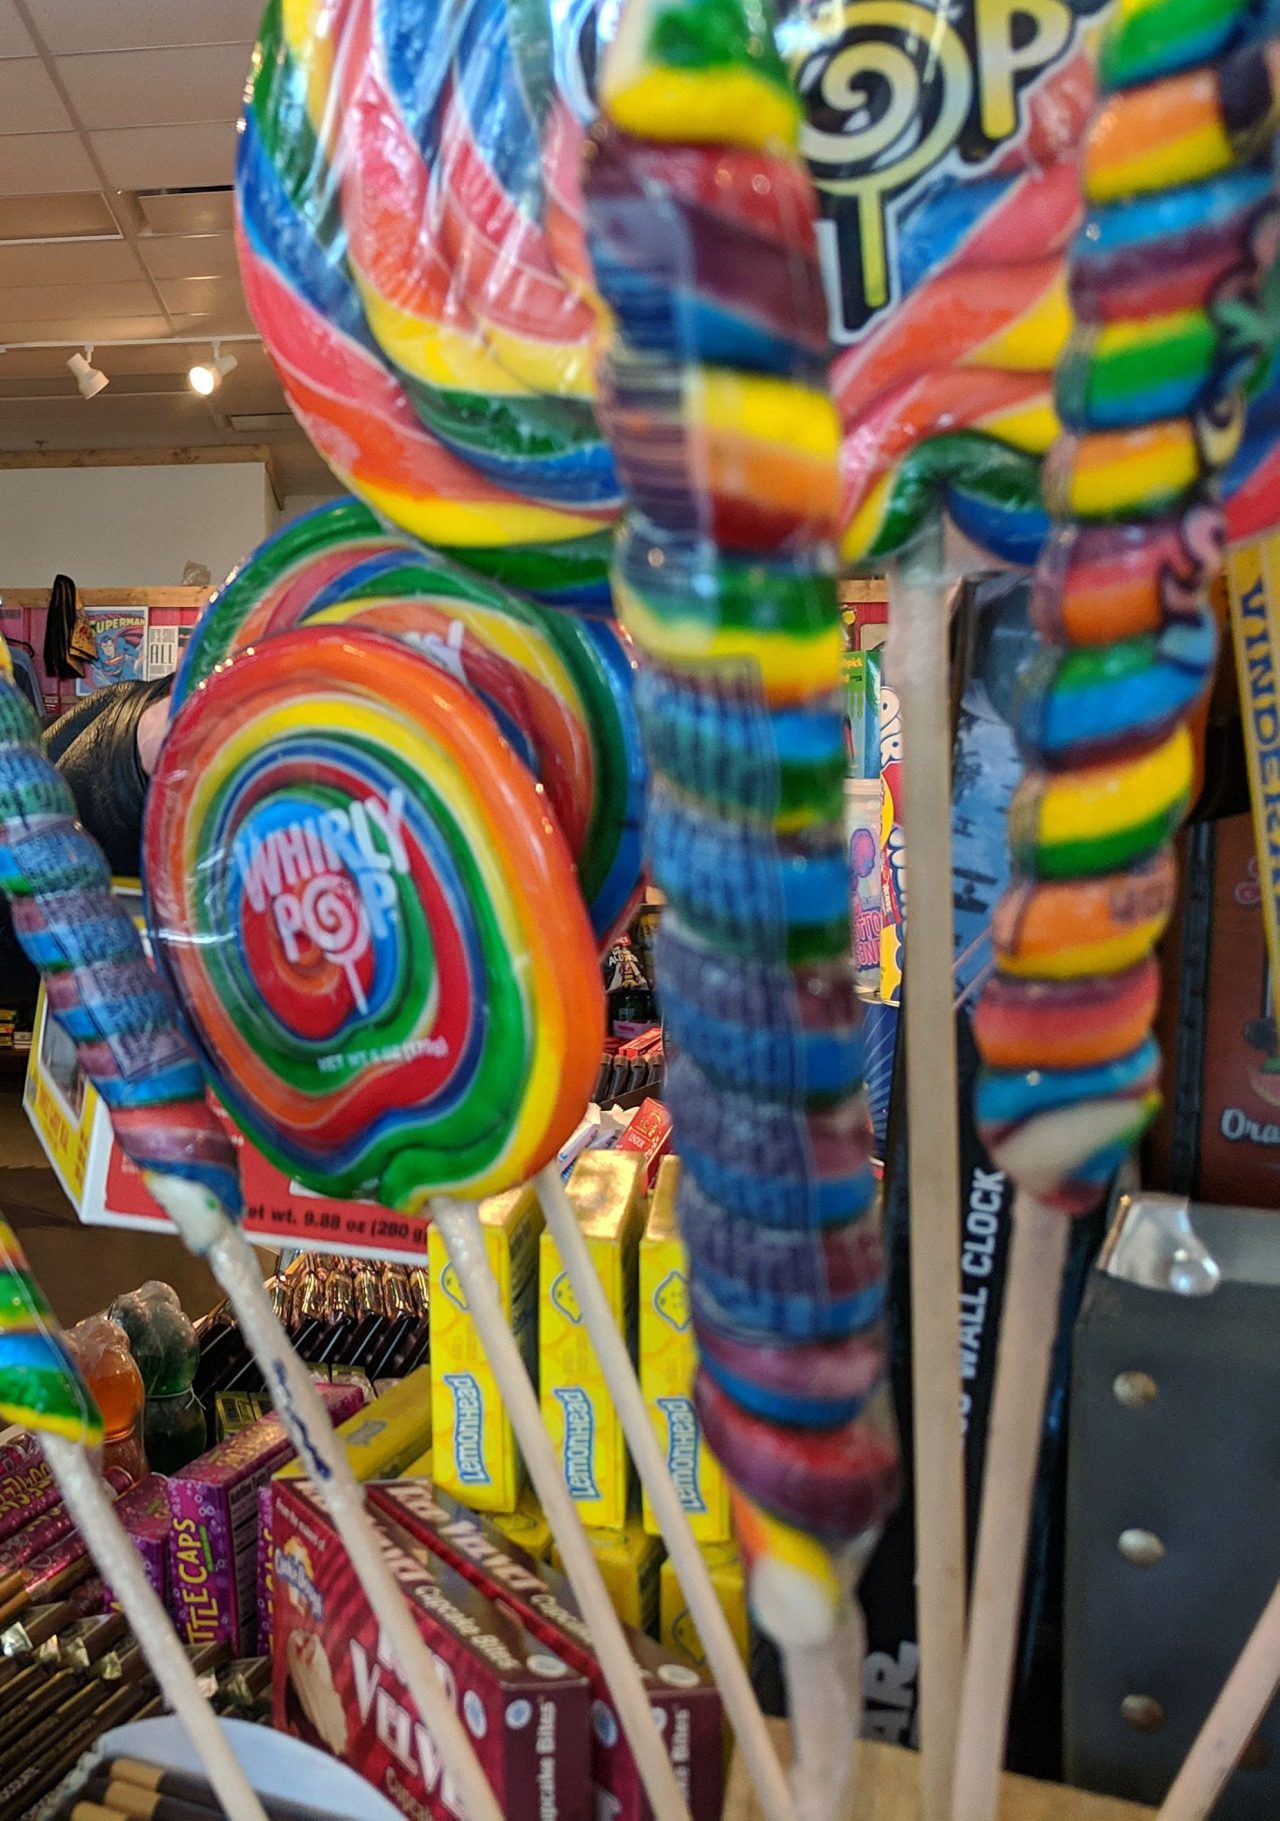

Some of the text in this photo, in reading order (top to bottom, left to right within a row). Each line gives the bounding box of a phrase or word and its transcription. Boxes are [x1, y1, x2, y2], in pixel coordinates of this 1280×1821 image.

[150, 644, 174, 664] ALL
[234, 788, 410, 912] WHIRLY
[274, 868, 399, 1010] POP
[1221, 1107, 1280, 1146] Ora
[248, 1203, 265, 1220] et
[304, 1211, 341, 1230] 9.88
[345, 1219, 365, 1234] oz
[961, 1167, 1005, 1278] CLOCK
[172, 1517, 219, 1645] TTLE CAPS
[414, 1585, 482, 1637] Cupcake
